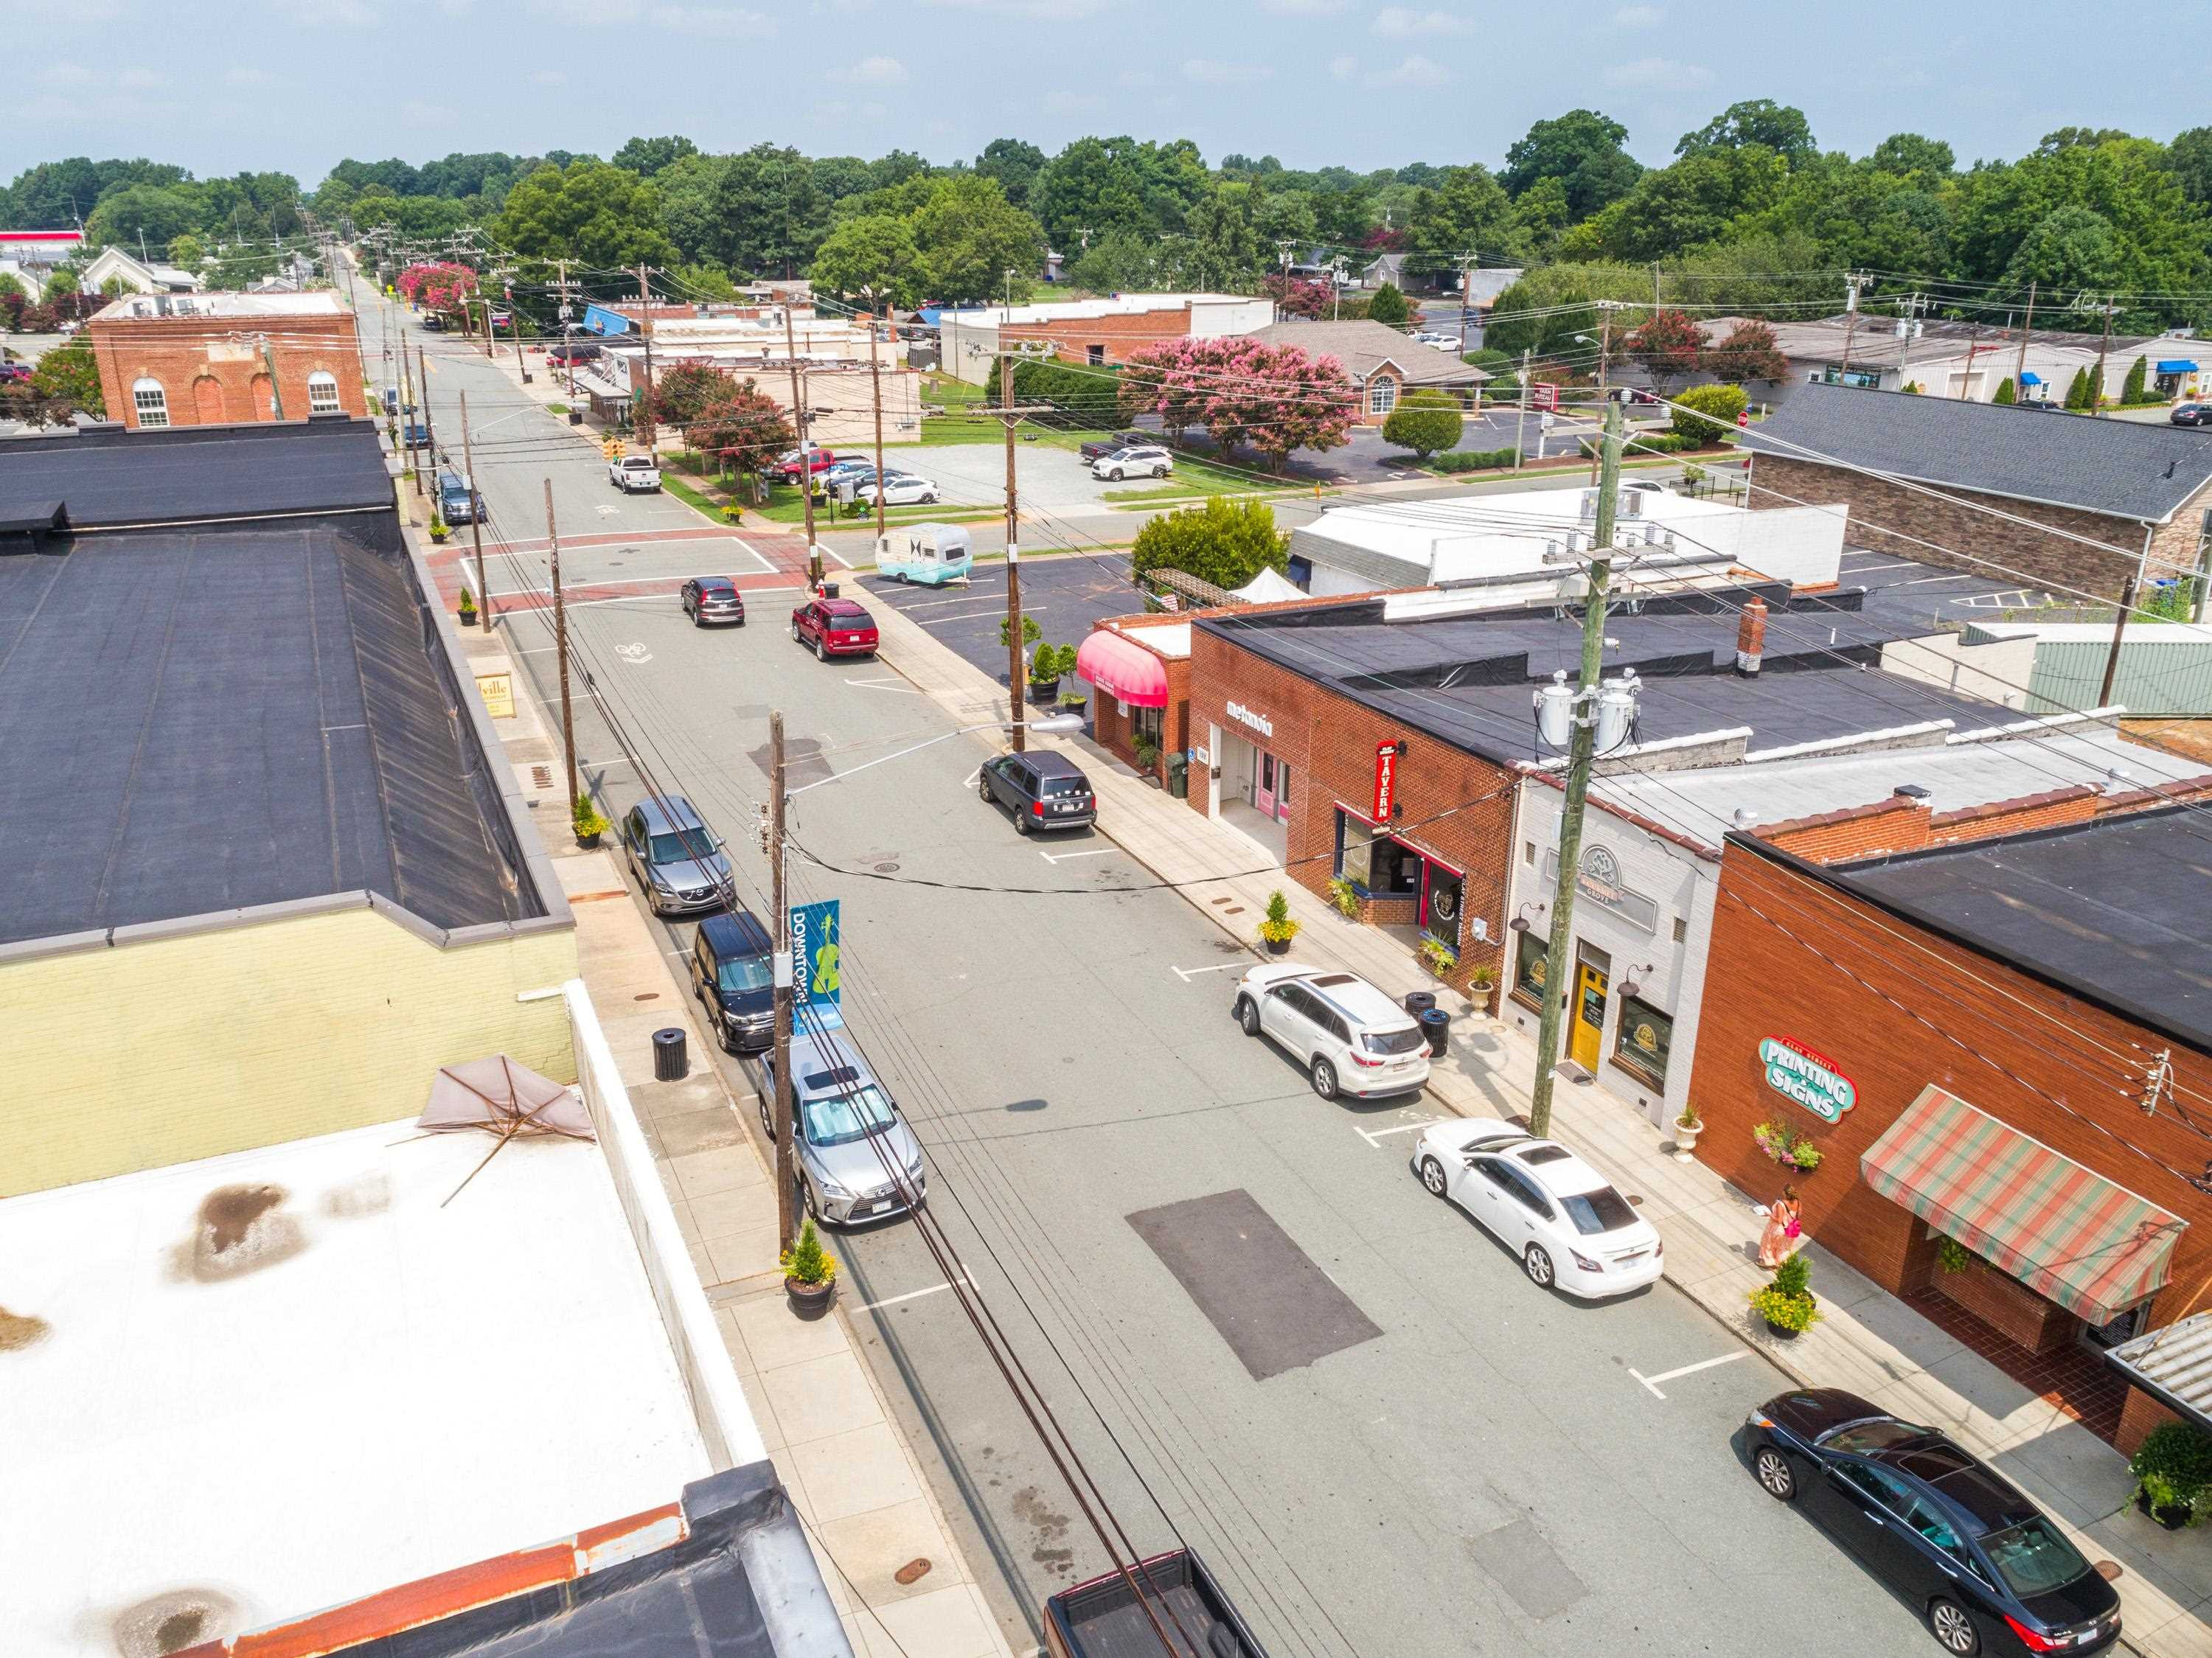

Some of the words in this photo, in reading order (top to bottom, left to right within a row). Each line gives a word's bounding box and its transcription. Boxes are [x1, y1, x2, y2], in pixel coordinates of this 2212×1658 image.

[1378, 756, 1392, 818] TAVERN
[1587, 888, 1610, 905] GROVE
[793, 912, 808, 1005] DOWNTOWN
[1765, 1041, 1848, 1106] PRINTING
[1770, 1067, 1835, 1118] SIGNS
